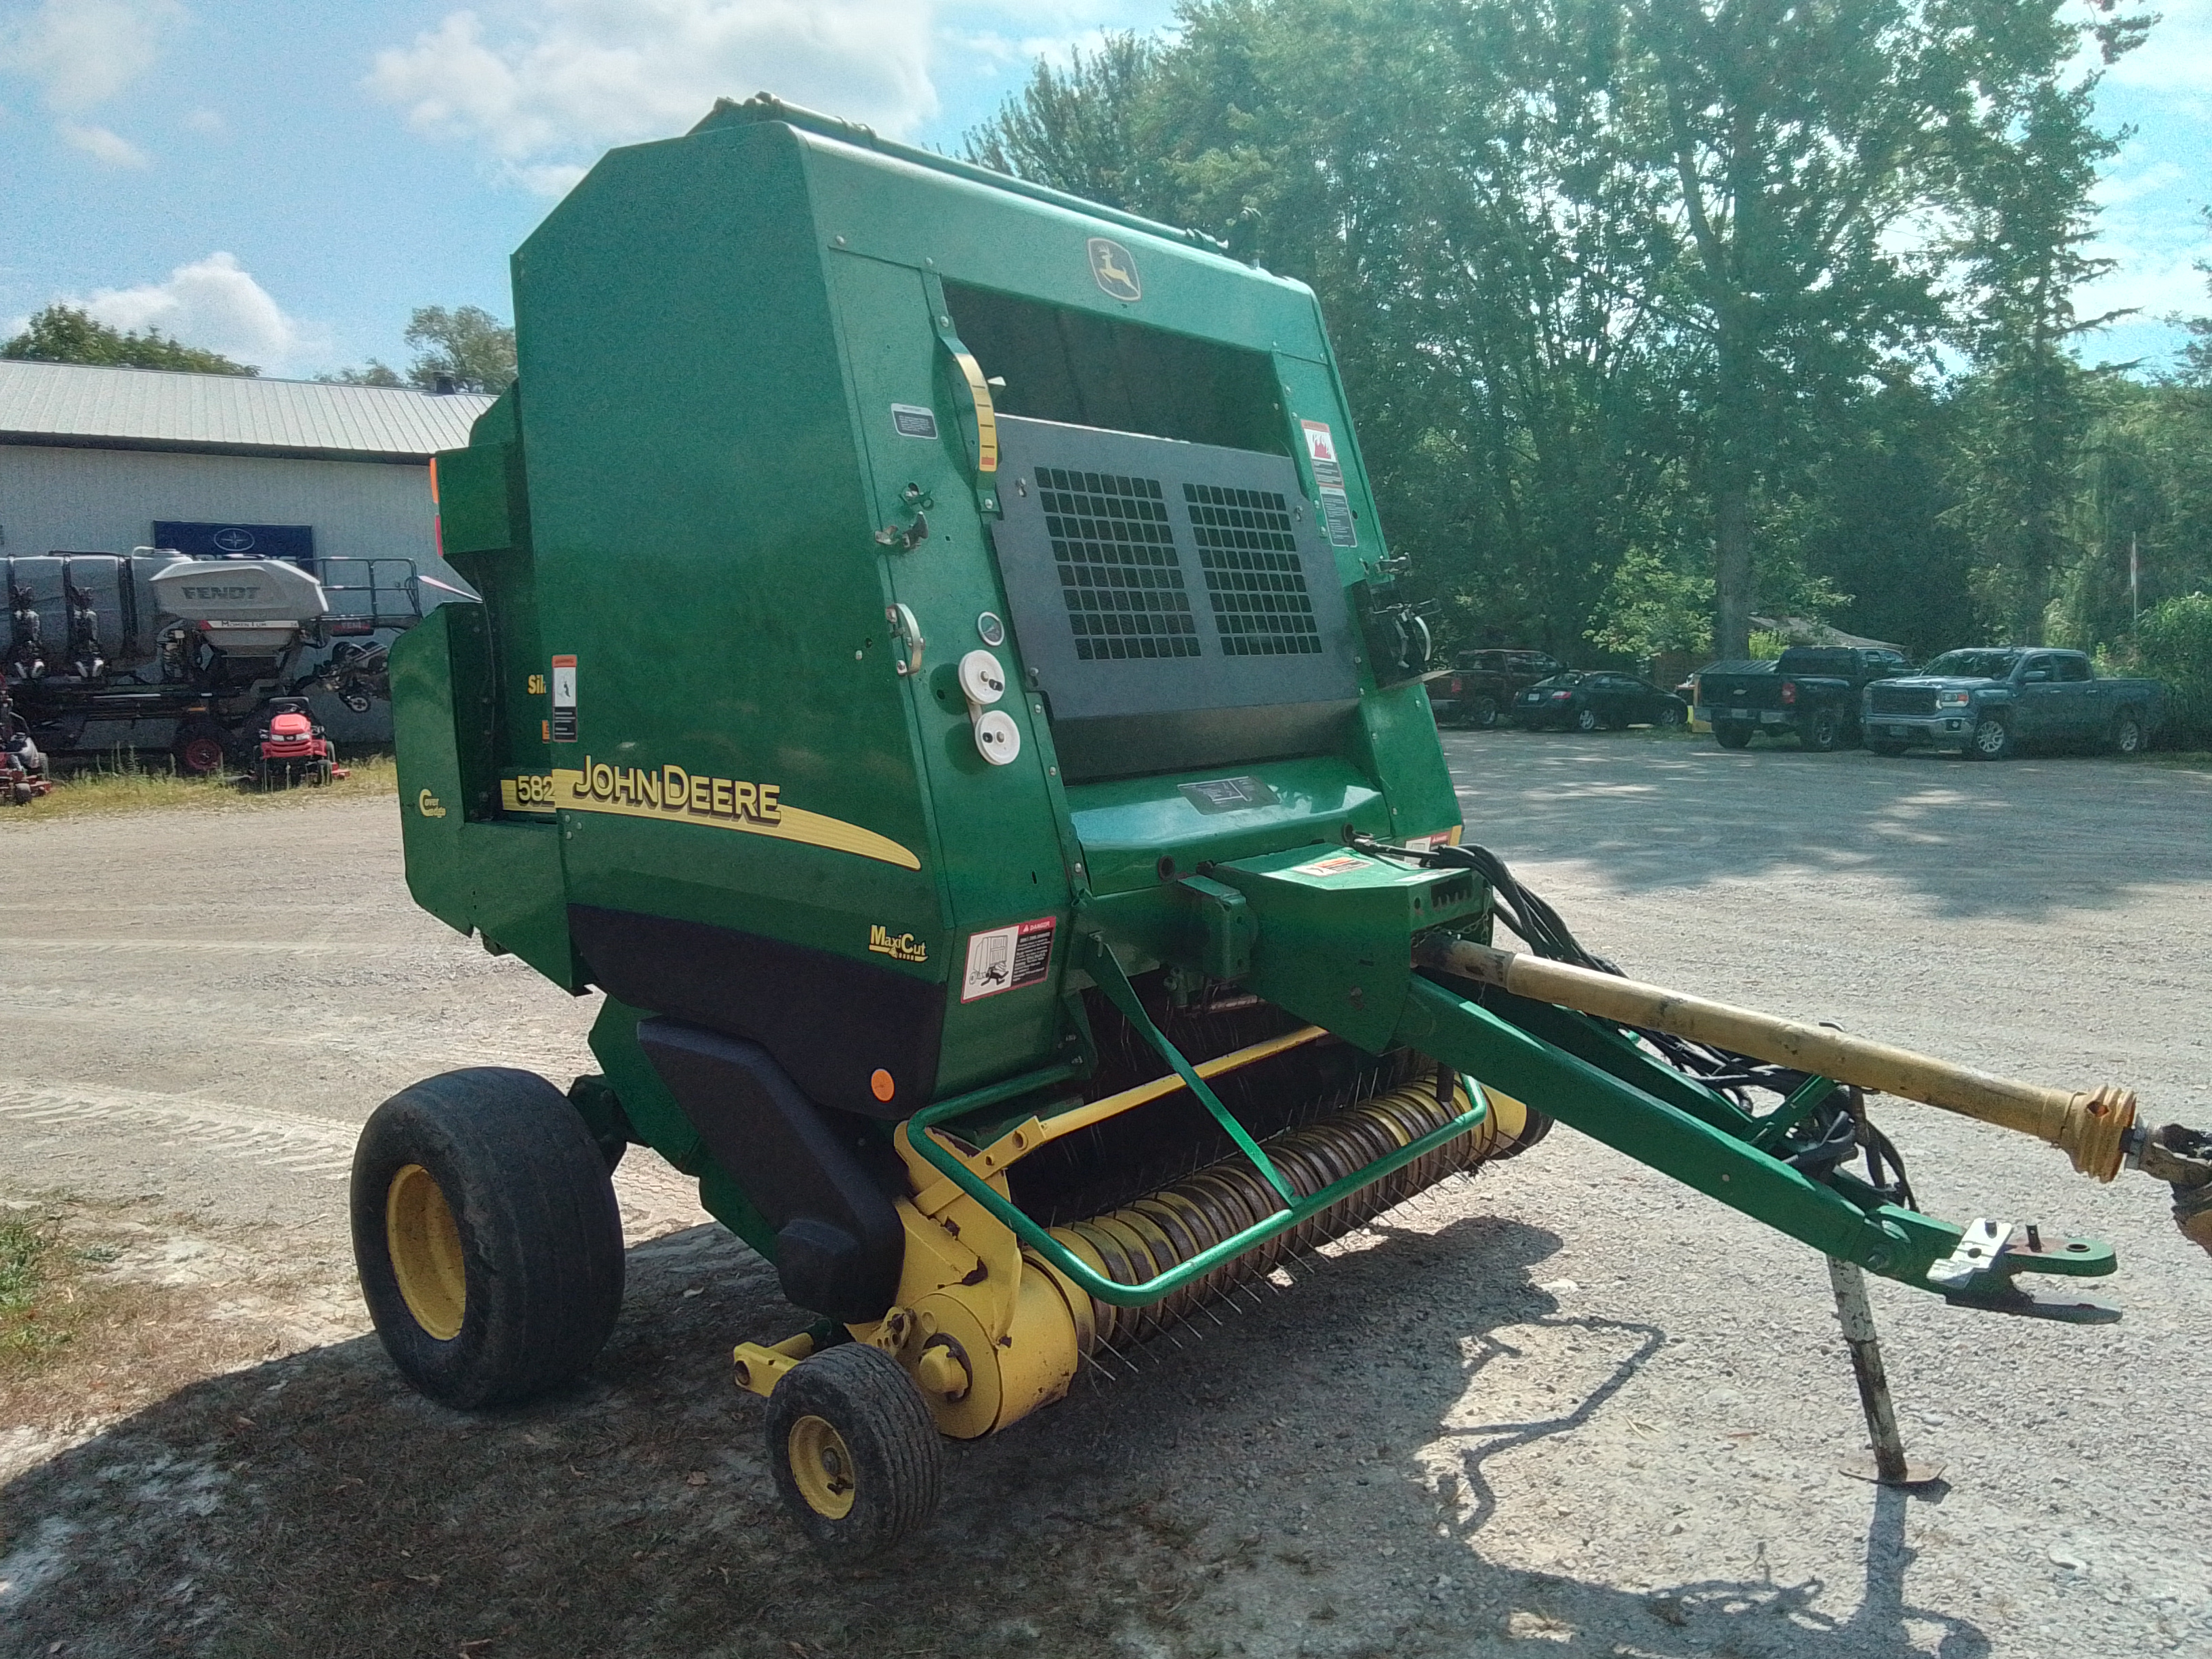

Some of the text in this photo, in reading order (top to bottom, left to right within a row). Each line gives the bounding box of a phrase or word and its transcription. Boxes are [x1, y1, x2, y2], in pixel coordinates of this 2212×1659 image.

[181, 586, 260, 600] FENDT
[528, 674, 546, 694] Sil
[517, 775, 556, 803] 582
[574, 755, 780, 821] JOHN DEERE
[870, 924, 926, 956] MaxiCut
